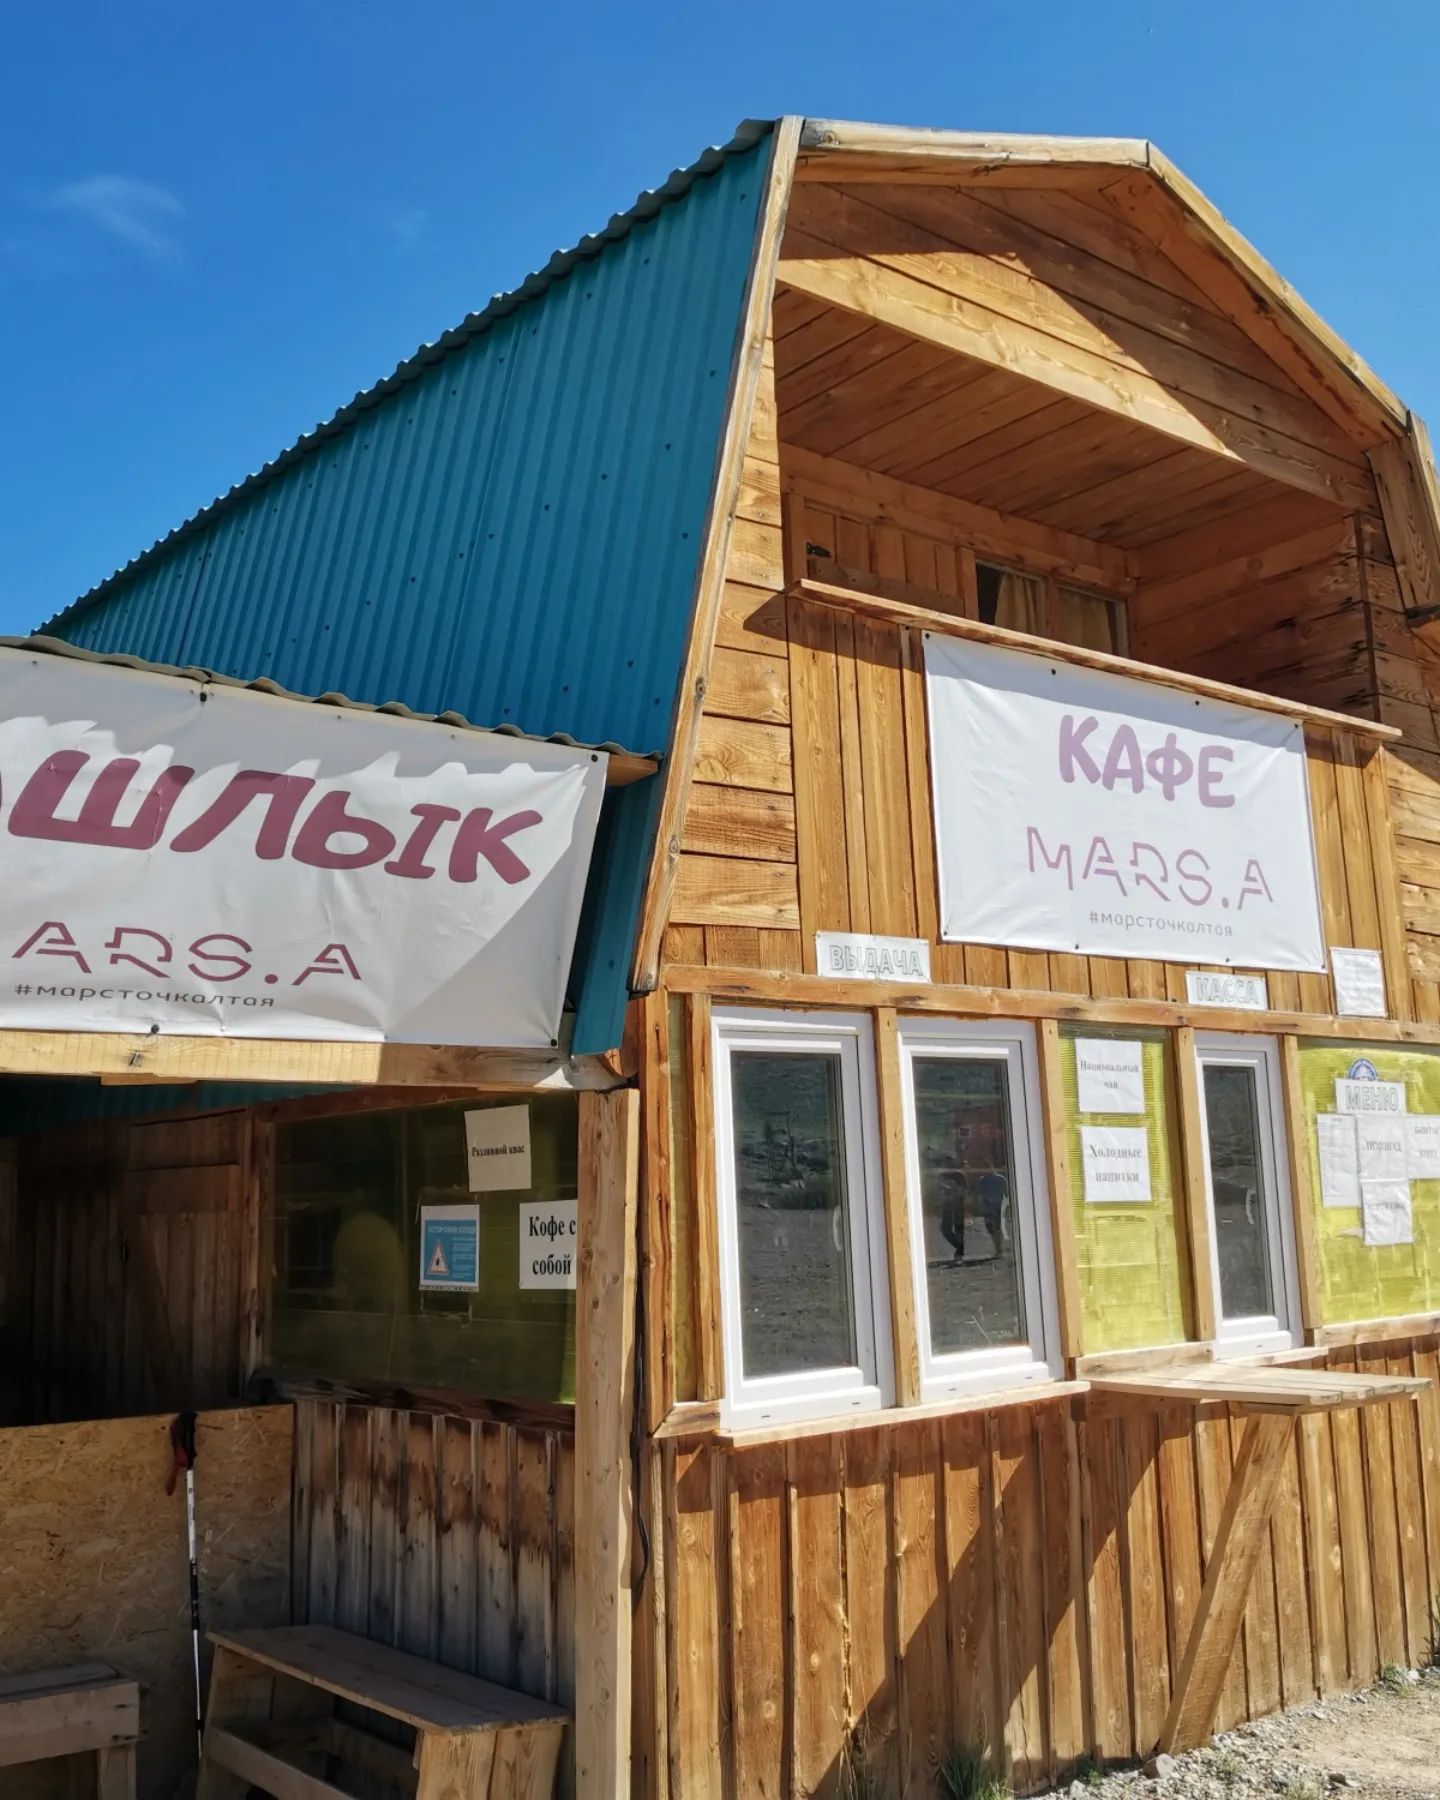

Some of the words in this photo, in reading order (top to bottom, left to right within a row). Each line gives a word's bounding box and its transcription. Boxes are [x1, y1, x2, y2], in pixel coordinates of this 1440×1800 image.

[1058, 715, 1236, 809] КАФЕ
[0, 750, 543, 885] ШЛЫК
[1026, 826, 1274, 911] MARS.A
[829, 944, 924, 979] ВЫДАЧА
[14, 983, 275, 1008] #марсточкалтая
[1195, 976, 1260, 1005] КАССА
[1344, 1085, 1400, 1113] МЕНЮ
[1089, 1143, 1142, 1159] Холодные
[1095, 1171, 1139, 1182] напитки
[528, 1215, 565, 1242] Кофе
[569, 1218, 576, 1230] с
[533, 1254, 571, 1275] собой
